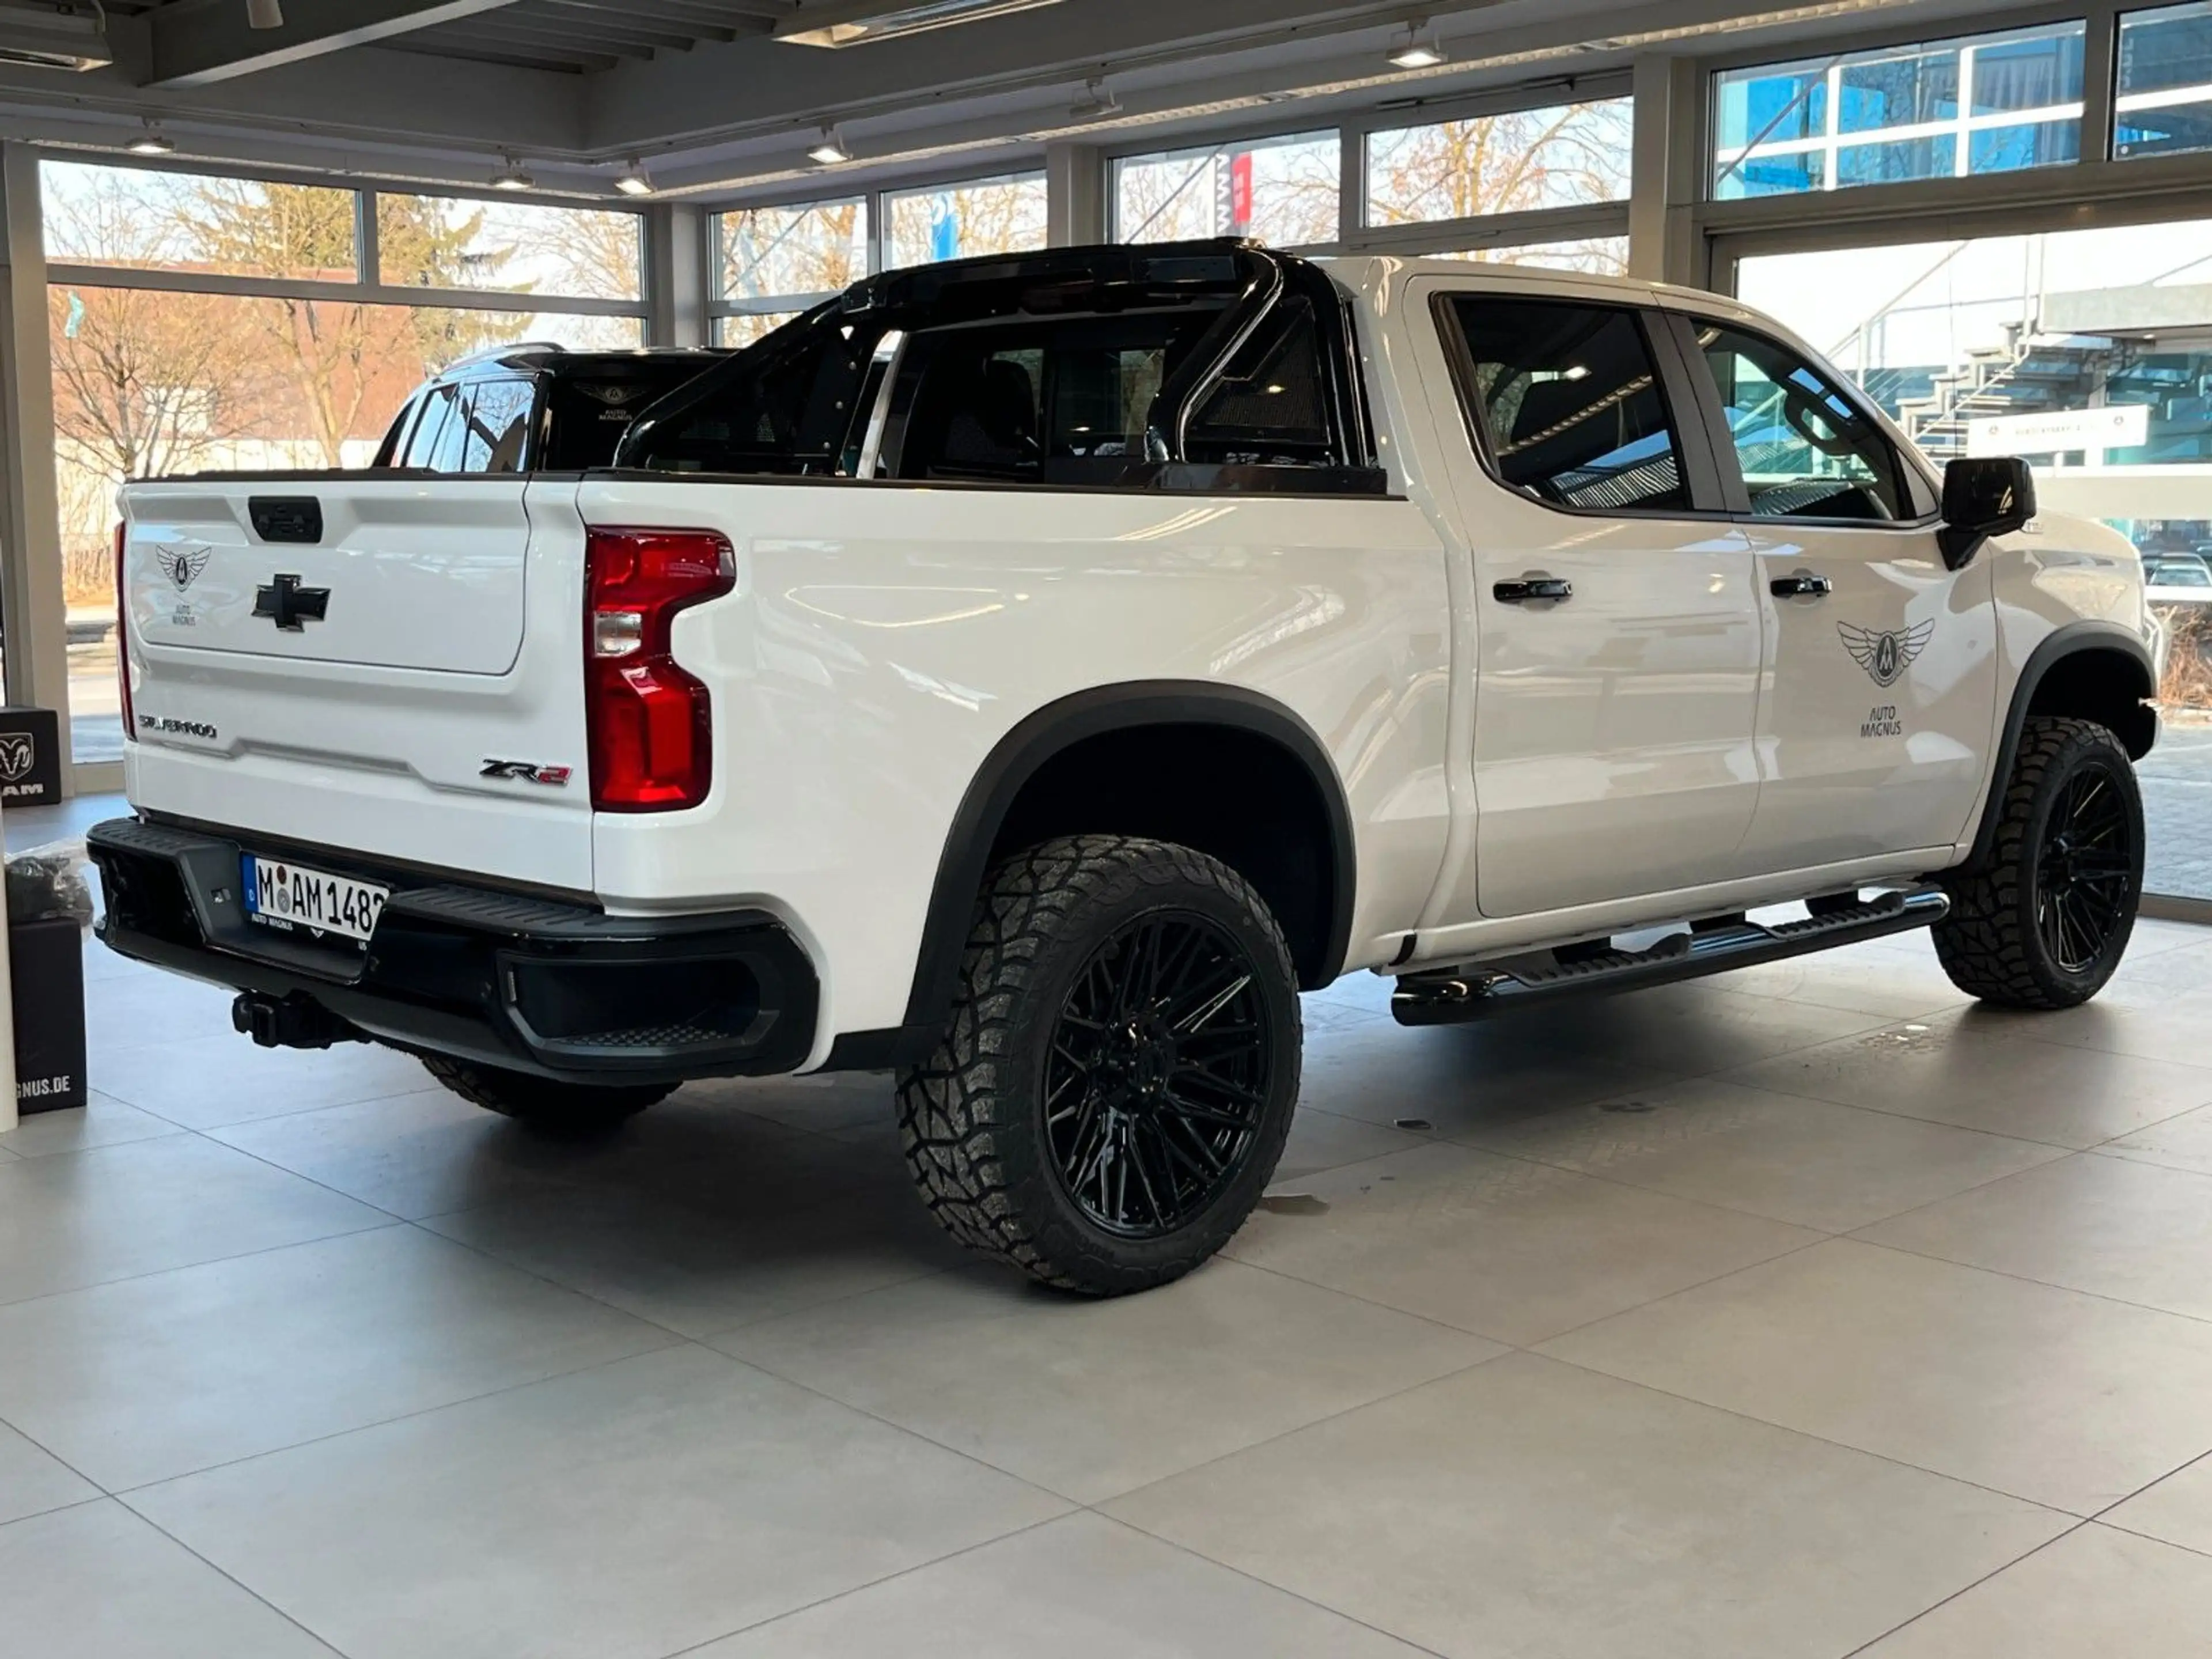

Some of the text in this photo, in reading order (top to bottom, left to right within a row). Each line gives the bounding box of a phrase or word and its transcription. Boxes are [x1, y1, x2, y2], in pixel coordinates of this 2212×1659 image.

[1870, 706, 1896, 721] AUTO
[1861, 721, 1901, 737] MAGNUS
[479, 759, 573, 788] ZR2
[2, 783, 44, 796] AM
[16, 1075, 70, 1099] GNUS.DE
